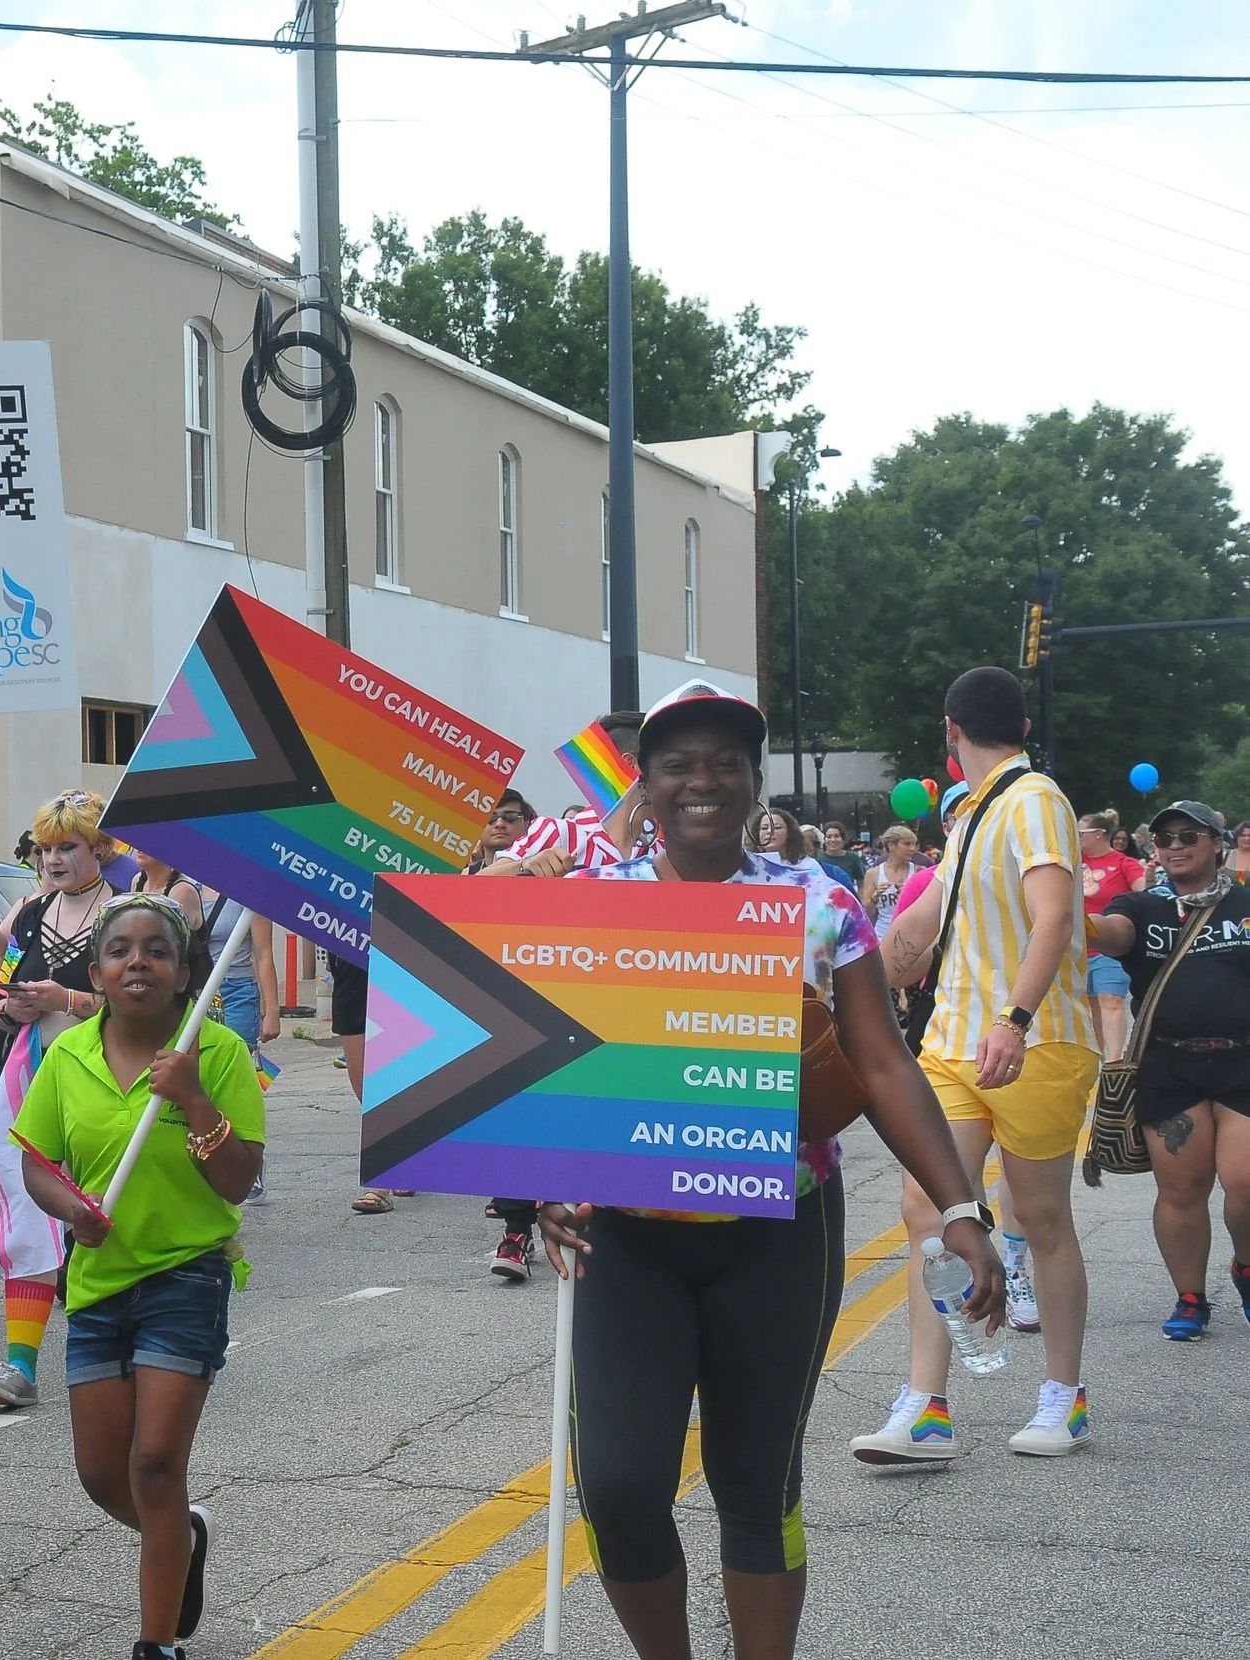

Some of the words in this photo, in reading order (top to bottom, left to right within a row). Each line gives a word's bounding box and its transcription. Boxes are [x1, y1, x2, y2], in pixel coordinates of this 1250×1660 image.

[7, 678, 36, 686] RECOVERY
[337, 663, 385, 701] YOU
[383, 692, 431, 729] CAN
[429, 716, 482, 759] HEAL
[483, 750, 516, 776] AS
[402, 751, 466, 797] MANY
[462, 788, 495, 815] AS
[388, 800, 415, 826] 75
[413, 815, 473, 858] LIVES
[343, 827, 377, 853] BY
[374, 845, 438, 875] SAYI
[270, 841, 328, 882] "YES"
[327, 873, 357, 900] TO
[359, 890, 374, 914] T
[736, 901, 803, 925] ANY
[880, 893, 898, 908] PR
[297, 902, 371, 955] DONAT
[1146, 917, 1250, 952] STR-M
[501, 943, 608, 972] LGBTQ+
[614, 948, 800, 977] COMMUNITY
[1146, 951, 1170, 960] STRON
[1210, 940, 1241, 950] RESILIENT
[665, 1010, 797, 1038] MEMBER
[683, 1064, 748, 1089] CAN
[755, 1069, 795, 1092] BE
[158, 1117, 190, 1128] VOLUNTEE
[630, 1121, 675, 1146] AN
[681, 1125, 792, 1153] ORGAN
[672, 1170, 791, 1201] DONOR.
